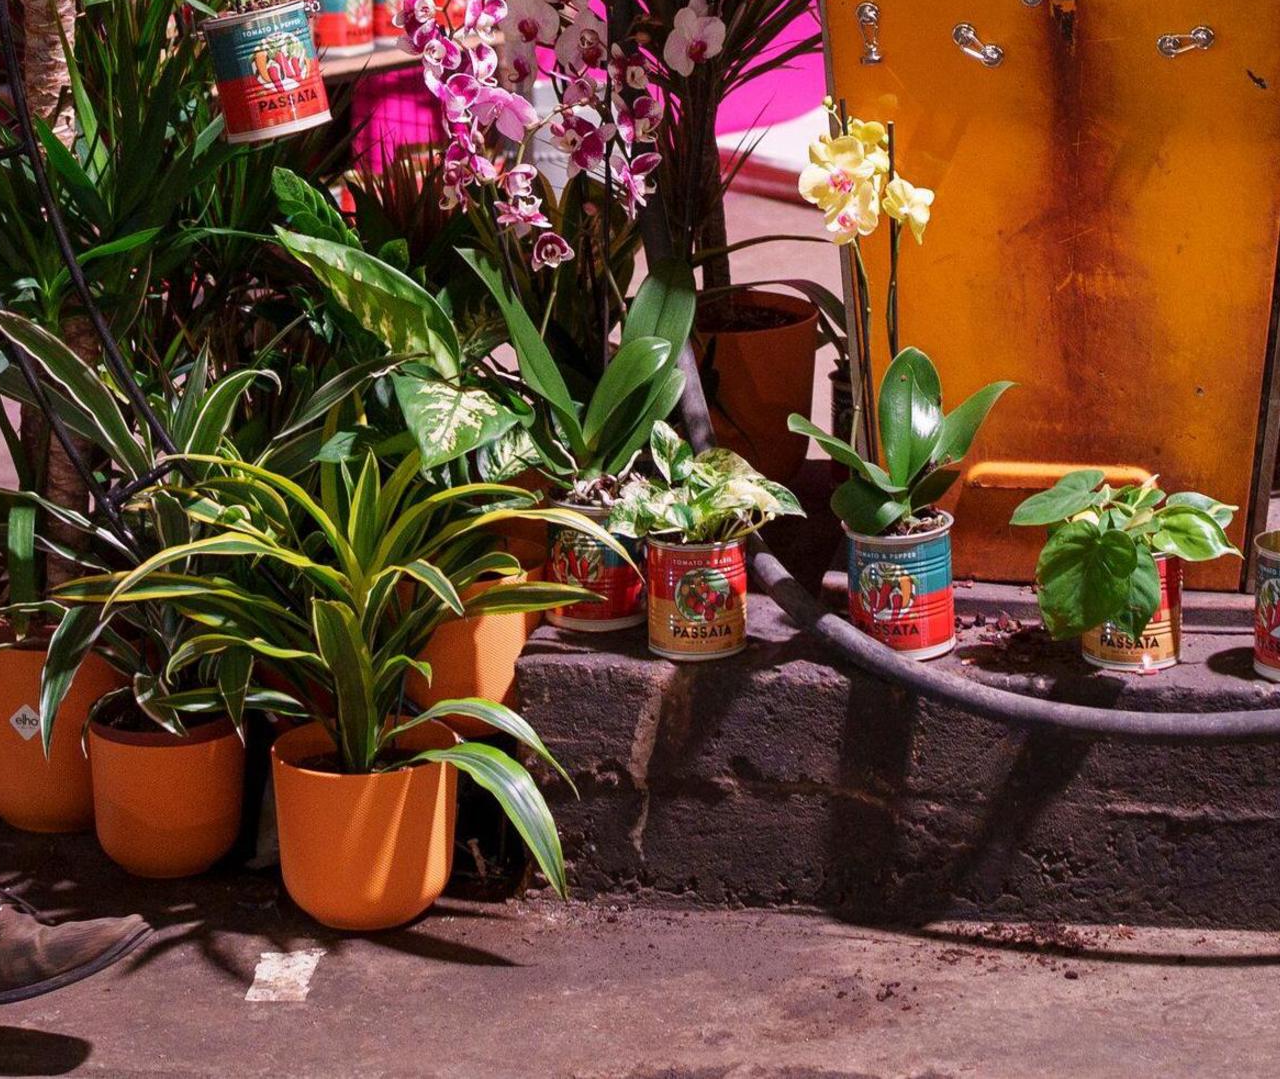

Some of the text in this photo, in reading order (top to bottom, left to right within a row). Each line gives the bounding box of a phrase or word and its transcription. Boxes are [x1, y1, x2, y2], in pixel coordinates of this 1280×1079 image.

[242, 26, 272, 38] TOMATO
[890, 551, 917, 560] PEPPER
[673, 624, 732, 638] PASSATA
[15, 713, 39, 726] elho
